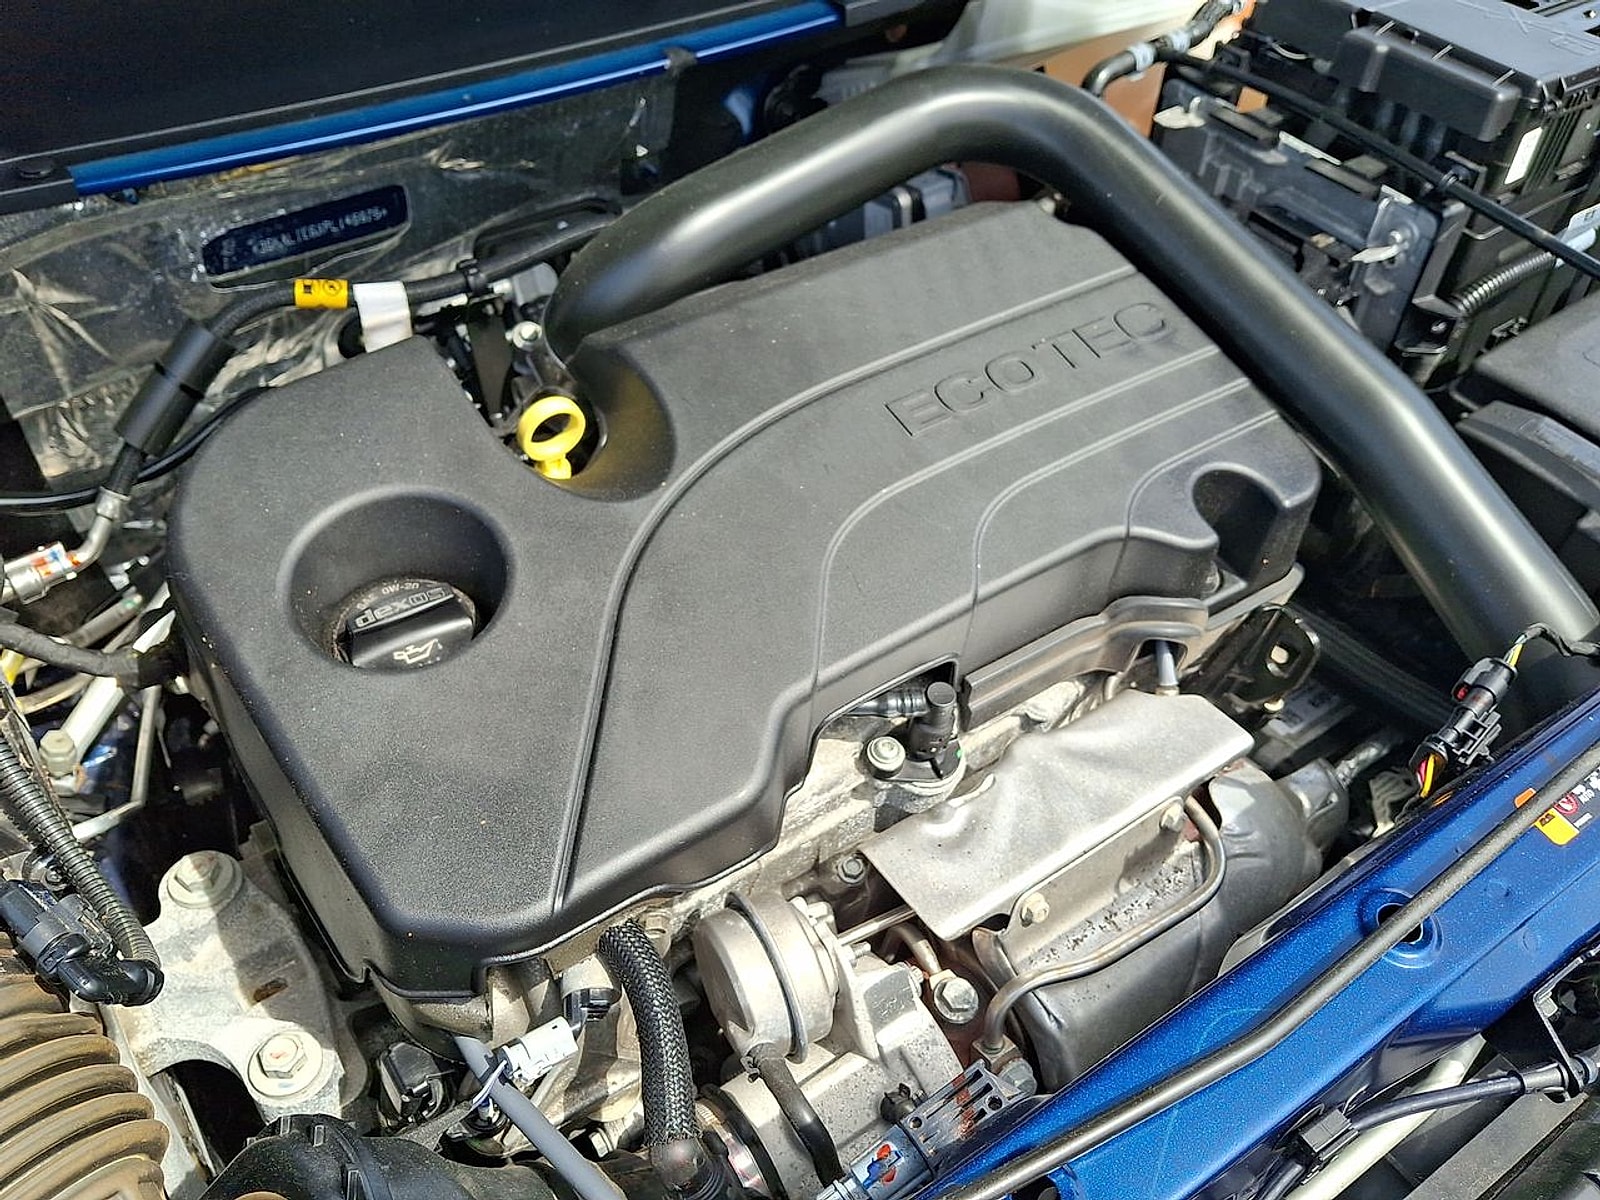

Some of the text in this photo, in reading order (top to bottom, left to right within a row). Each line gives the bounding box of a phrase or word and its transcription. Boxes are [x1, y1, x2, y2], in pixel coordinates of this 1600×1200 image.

[883, 301, 1171, 439] ECOTEC
[355, 587, 446, 627] dexos
[381, 582, 420, 595] 0W-20
